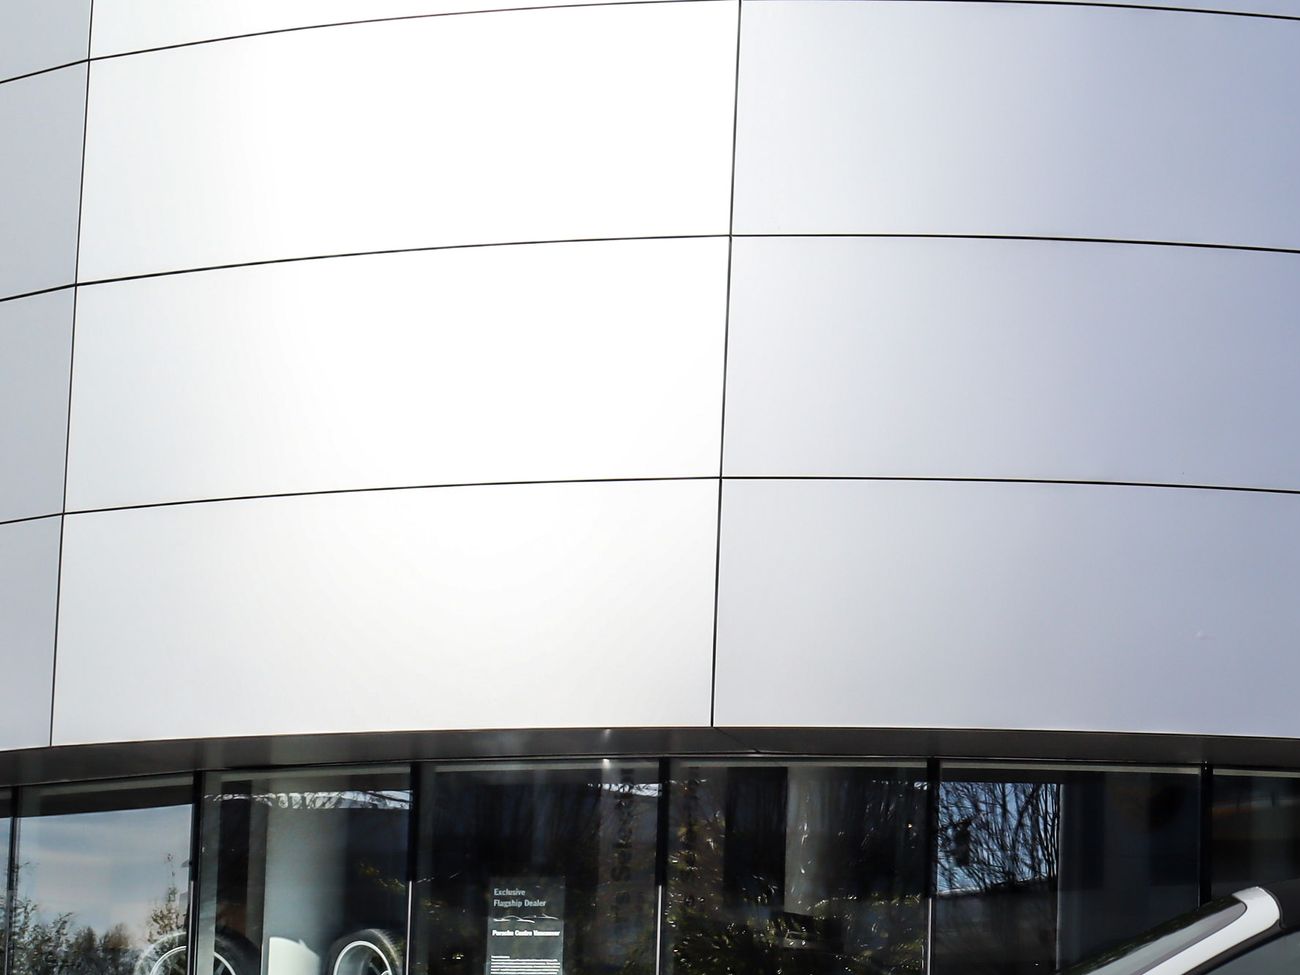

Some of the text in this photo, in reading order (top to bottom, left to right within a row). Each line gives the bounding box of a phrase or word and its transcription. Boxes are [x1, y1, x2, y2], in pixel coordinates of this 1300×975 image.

[493, 888, 526, 896] Exclusive
[493, 899, 546, 908] Flagship Dealer
